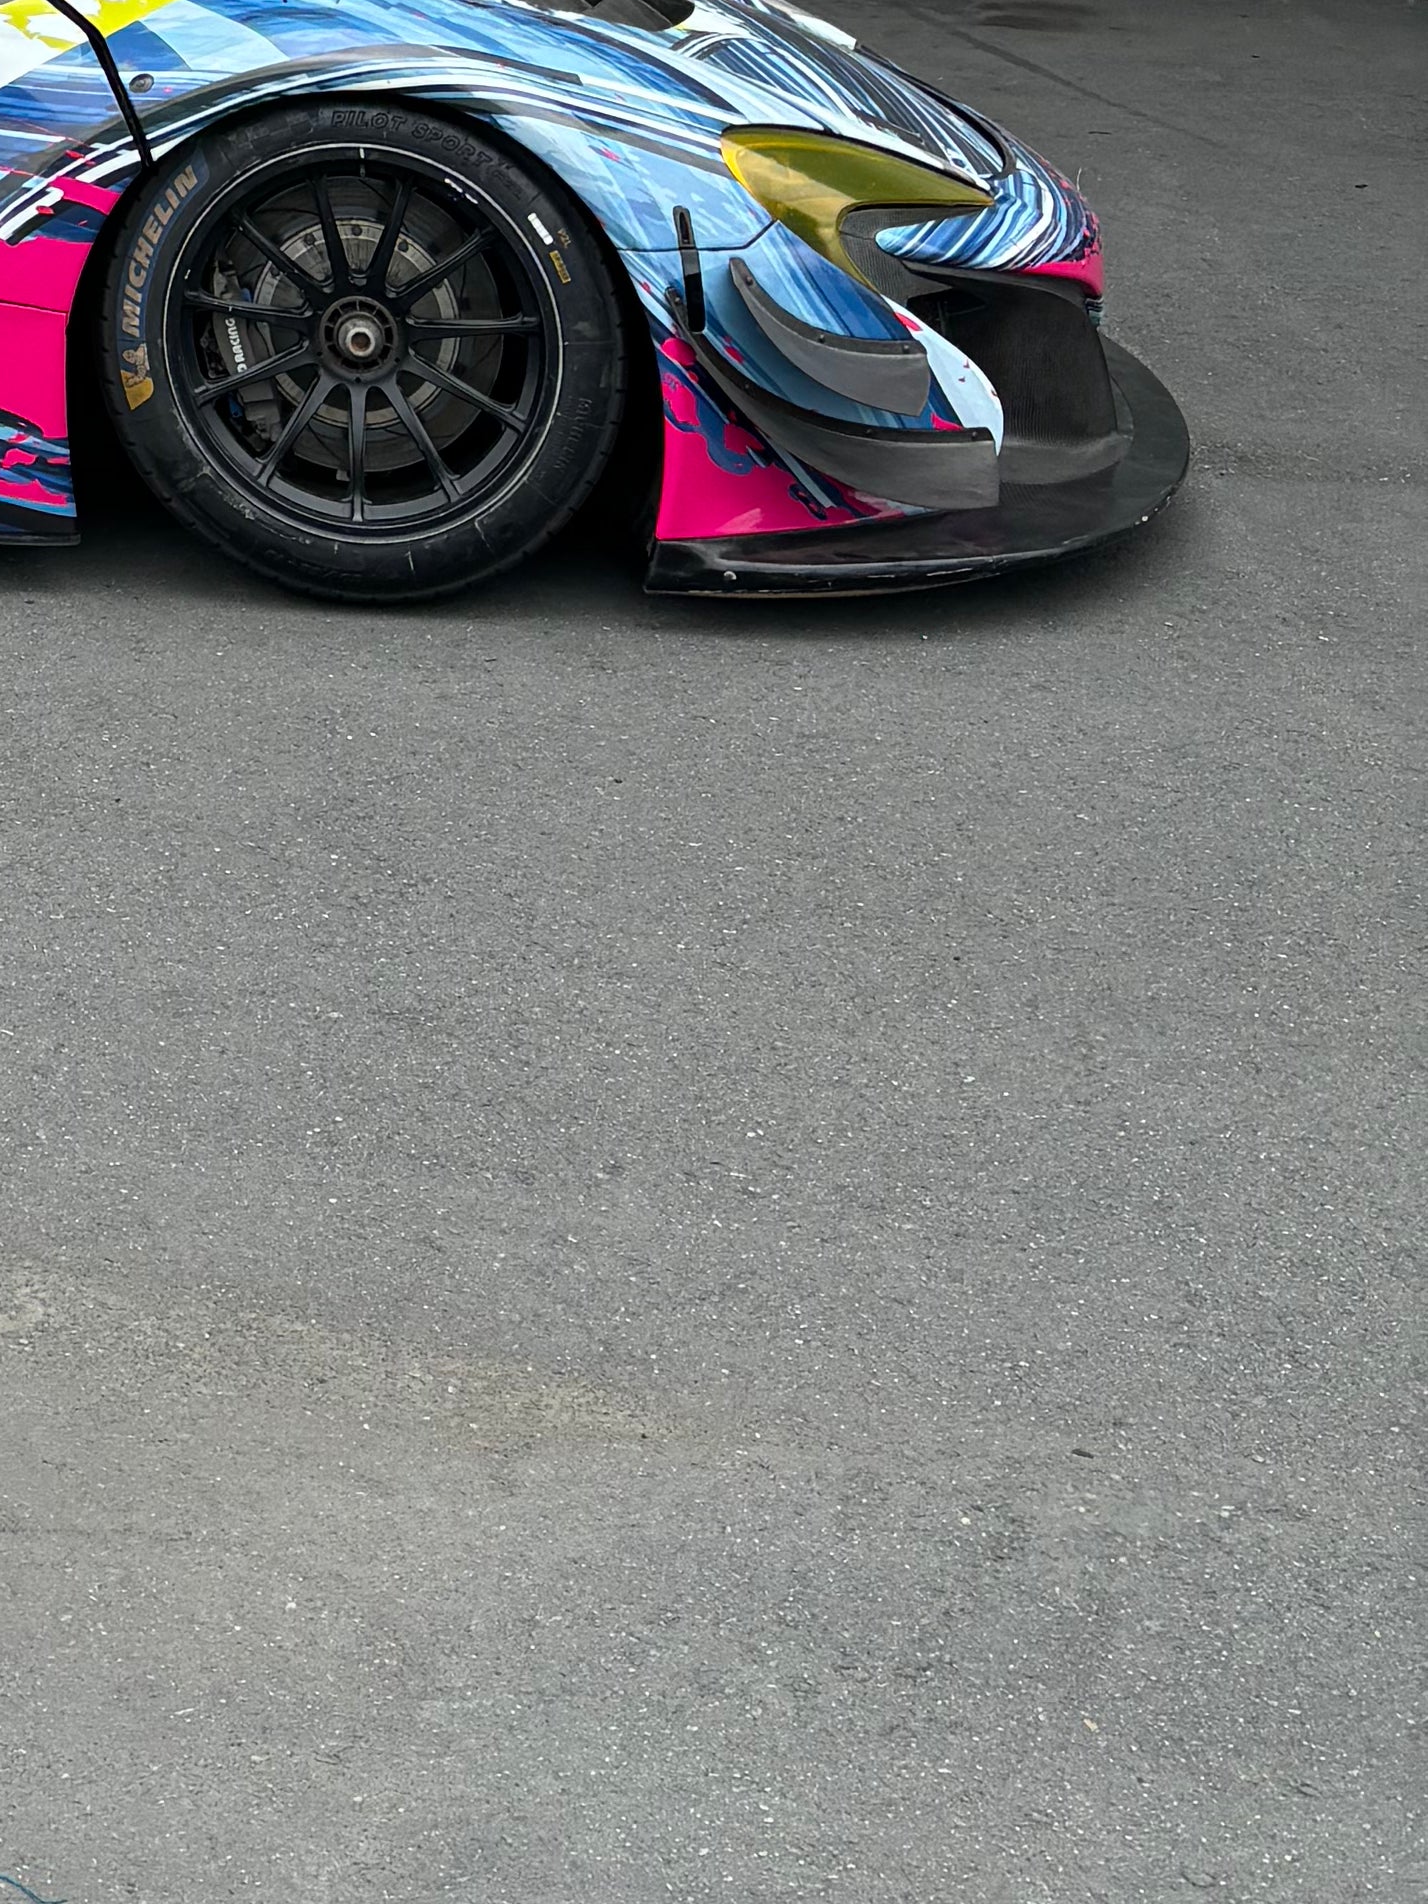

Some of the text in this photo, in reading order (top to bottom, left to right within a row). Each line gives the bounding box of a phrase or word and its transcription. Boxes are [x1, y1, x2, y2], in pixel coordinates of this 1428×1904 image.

[330, 109, 493, 168] PILOT SPORT
[122, 164, 198, 338] MICHELIN
[225, 317, 245, 363] RACING
